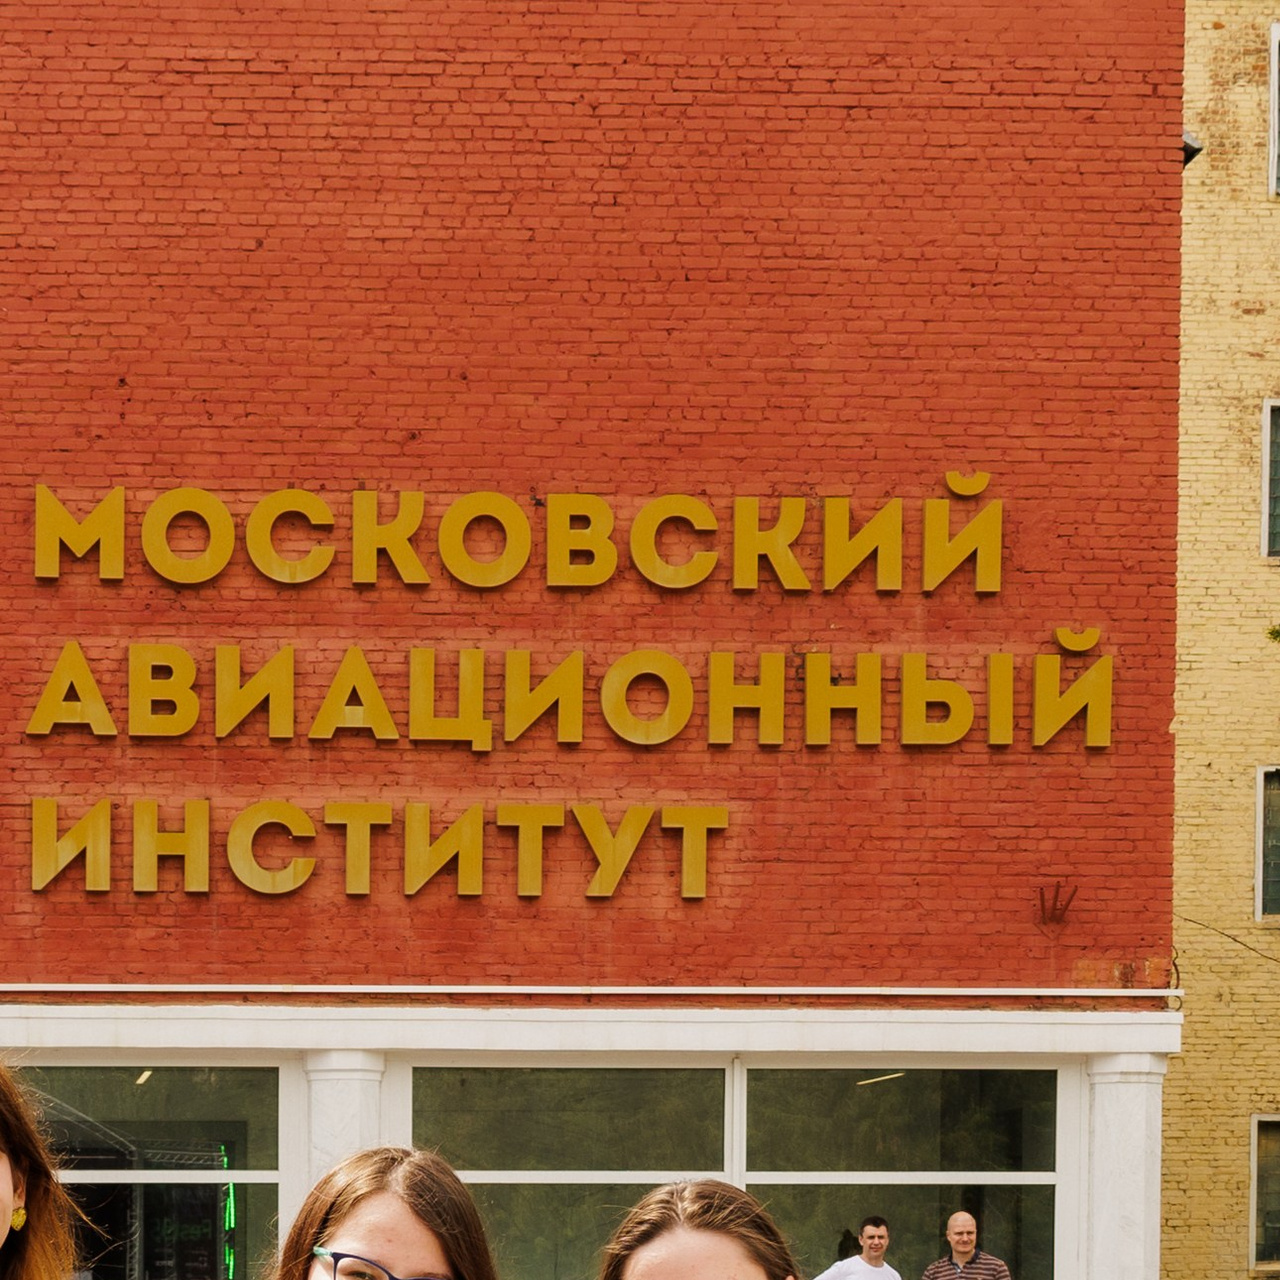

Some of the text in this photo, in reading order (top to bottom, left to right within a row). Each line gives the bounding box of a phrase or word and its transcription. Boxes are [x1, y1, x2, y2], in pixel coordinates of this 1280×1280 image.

[34, 470, 1003, 592] МОСКОВСКИЙ
[26, 627, 1114, 751] АВИАЦИОННЫЙ
[30, 799, 729, 899] ИНСТИТУТ
